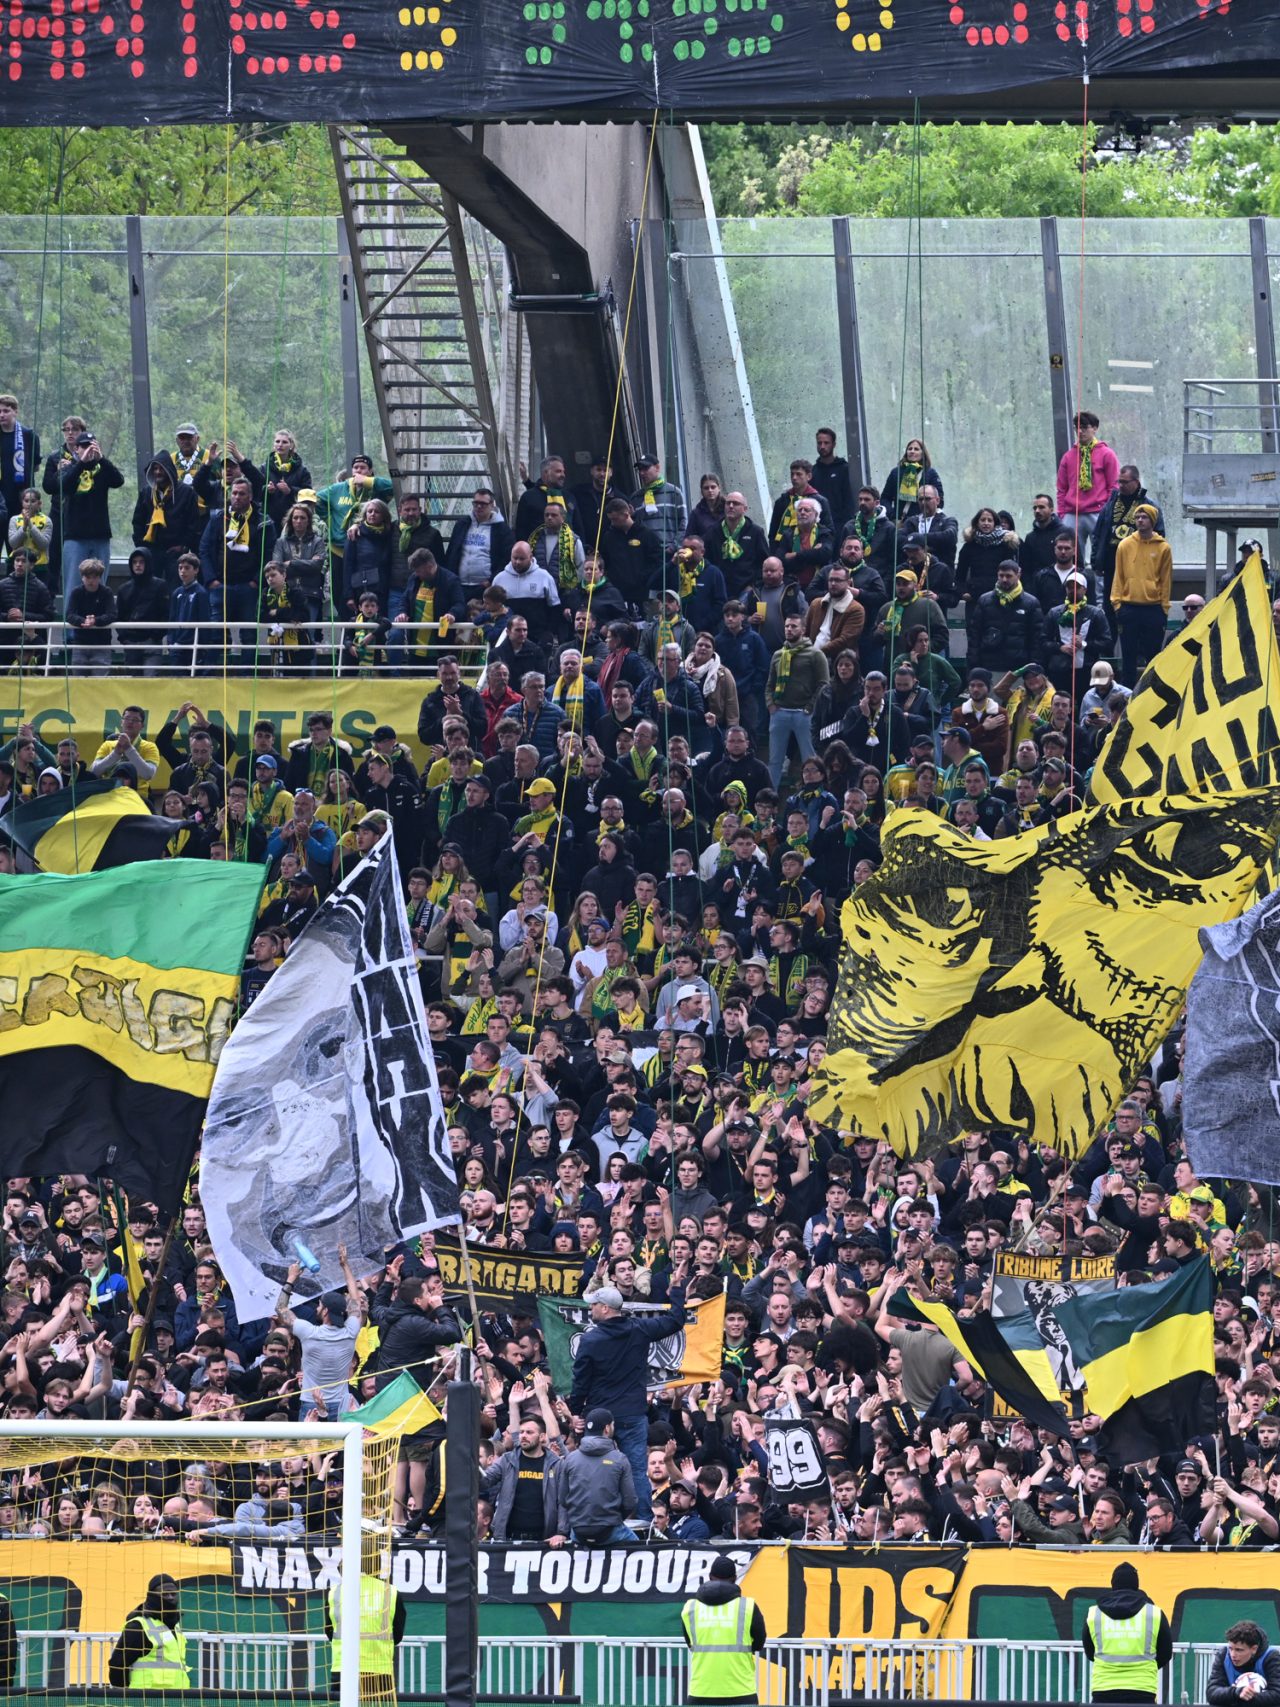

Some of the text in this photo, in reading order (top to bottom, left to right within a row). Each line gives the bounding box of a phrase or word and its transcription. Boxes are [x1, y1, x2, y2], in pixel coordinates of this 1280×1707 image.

[103, 707, 378, 759] NANTS
[437, 1253, 584, 1297] BRIGADE
[996, 1253, 1116, 1280] TRIBUNE LOIRE
[766, 1427, 826, 1491] 99
